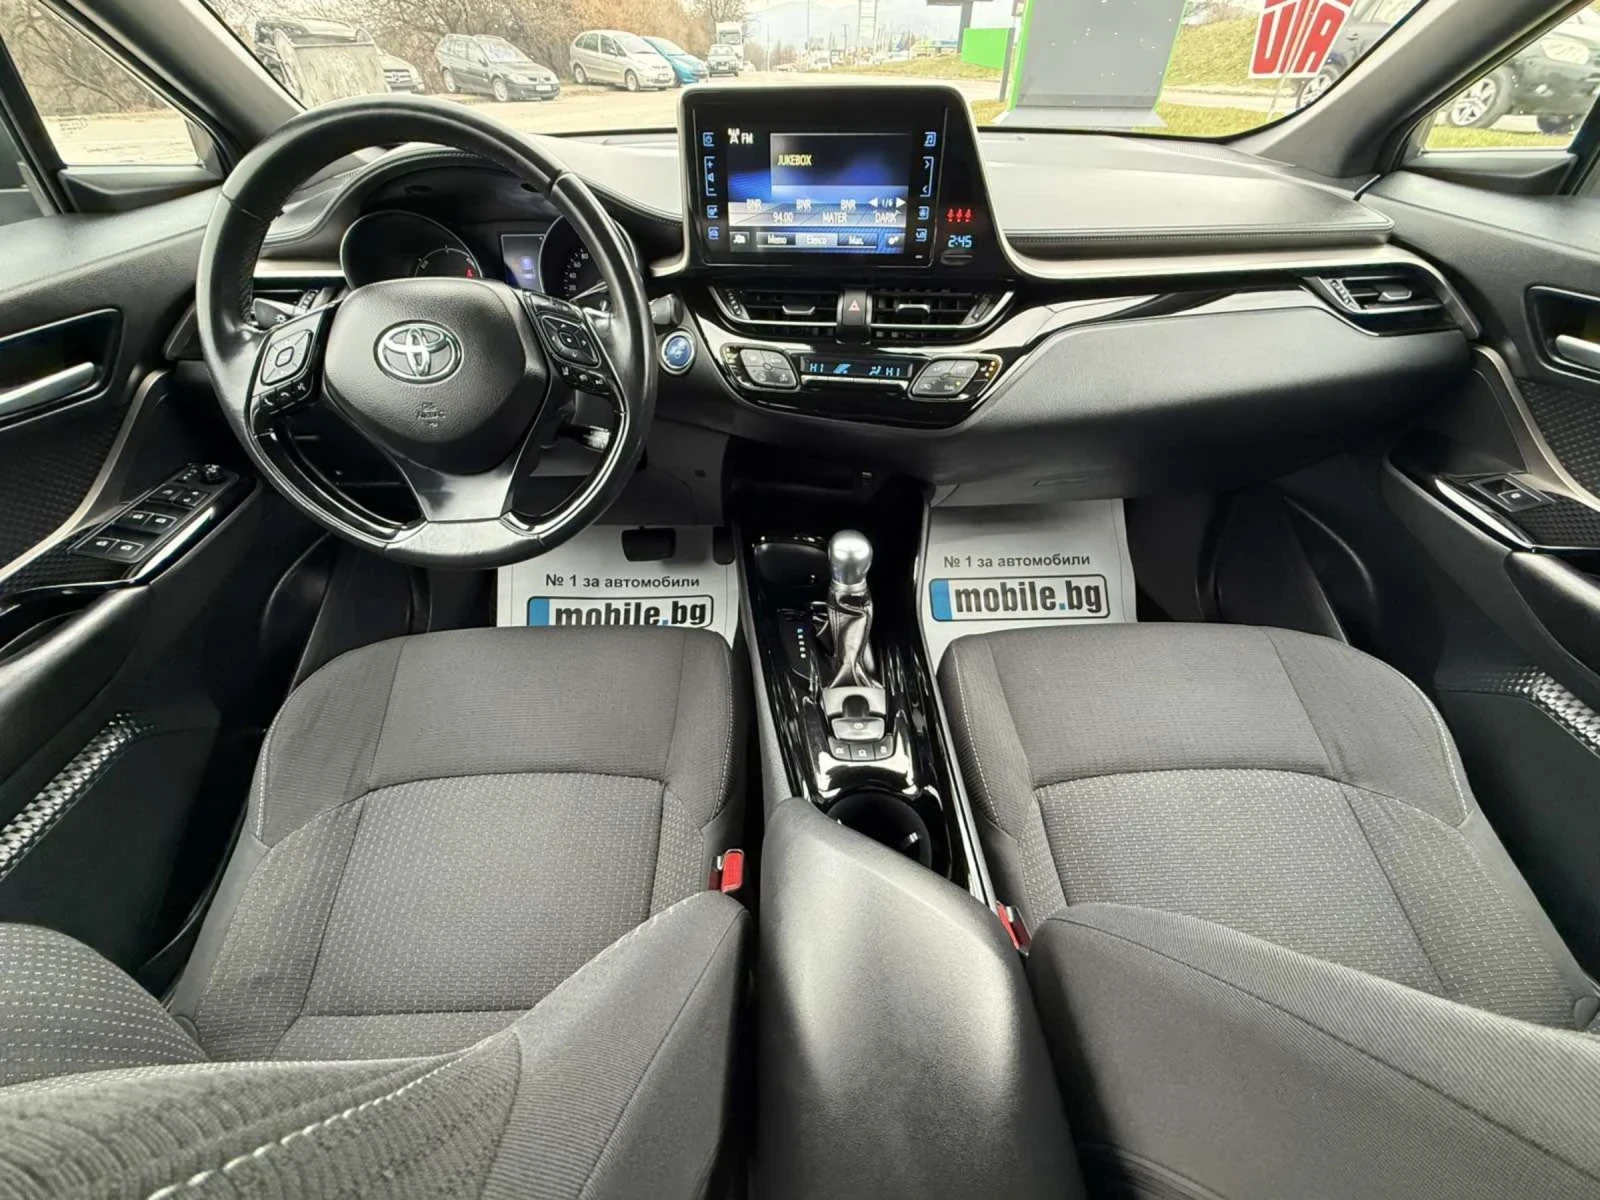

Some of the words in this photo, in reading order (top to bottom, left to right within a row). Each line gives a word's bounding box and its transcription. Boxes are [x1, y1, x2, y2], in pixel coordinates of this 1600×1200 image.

[741, 132, 754, 144] FM
[777, 154, 812, 166] JUKEBOX
[947, 234, 972, 248] 2:45
[809, 363, 824, 373] HI
[885, 367, 900, 377] HI
[965, 555, 973, 567] 1
[977, 557, 993, 567] за
[997, 553, 1091, 567] автомобили
[569, 574, 577, 587] 1
[582, 576, 600, 588] за
[604, 575, 700, 588] автомобили
[954, 579, 1102, 613] mobile.bg
[554, 600, 706, 626] mobile.bg
